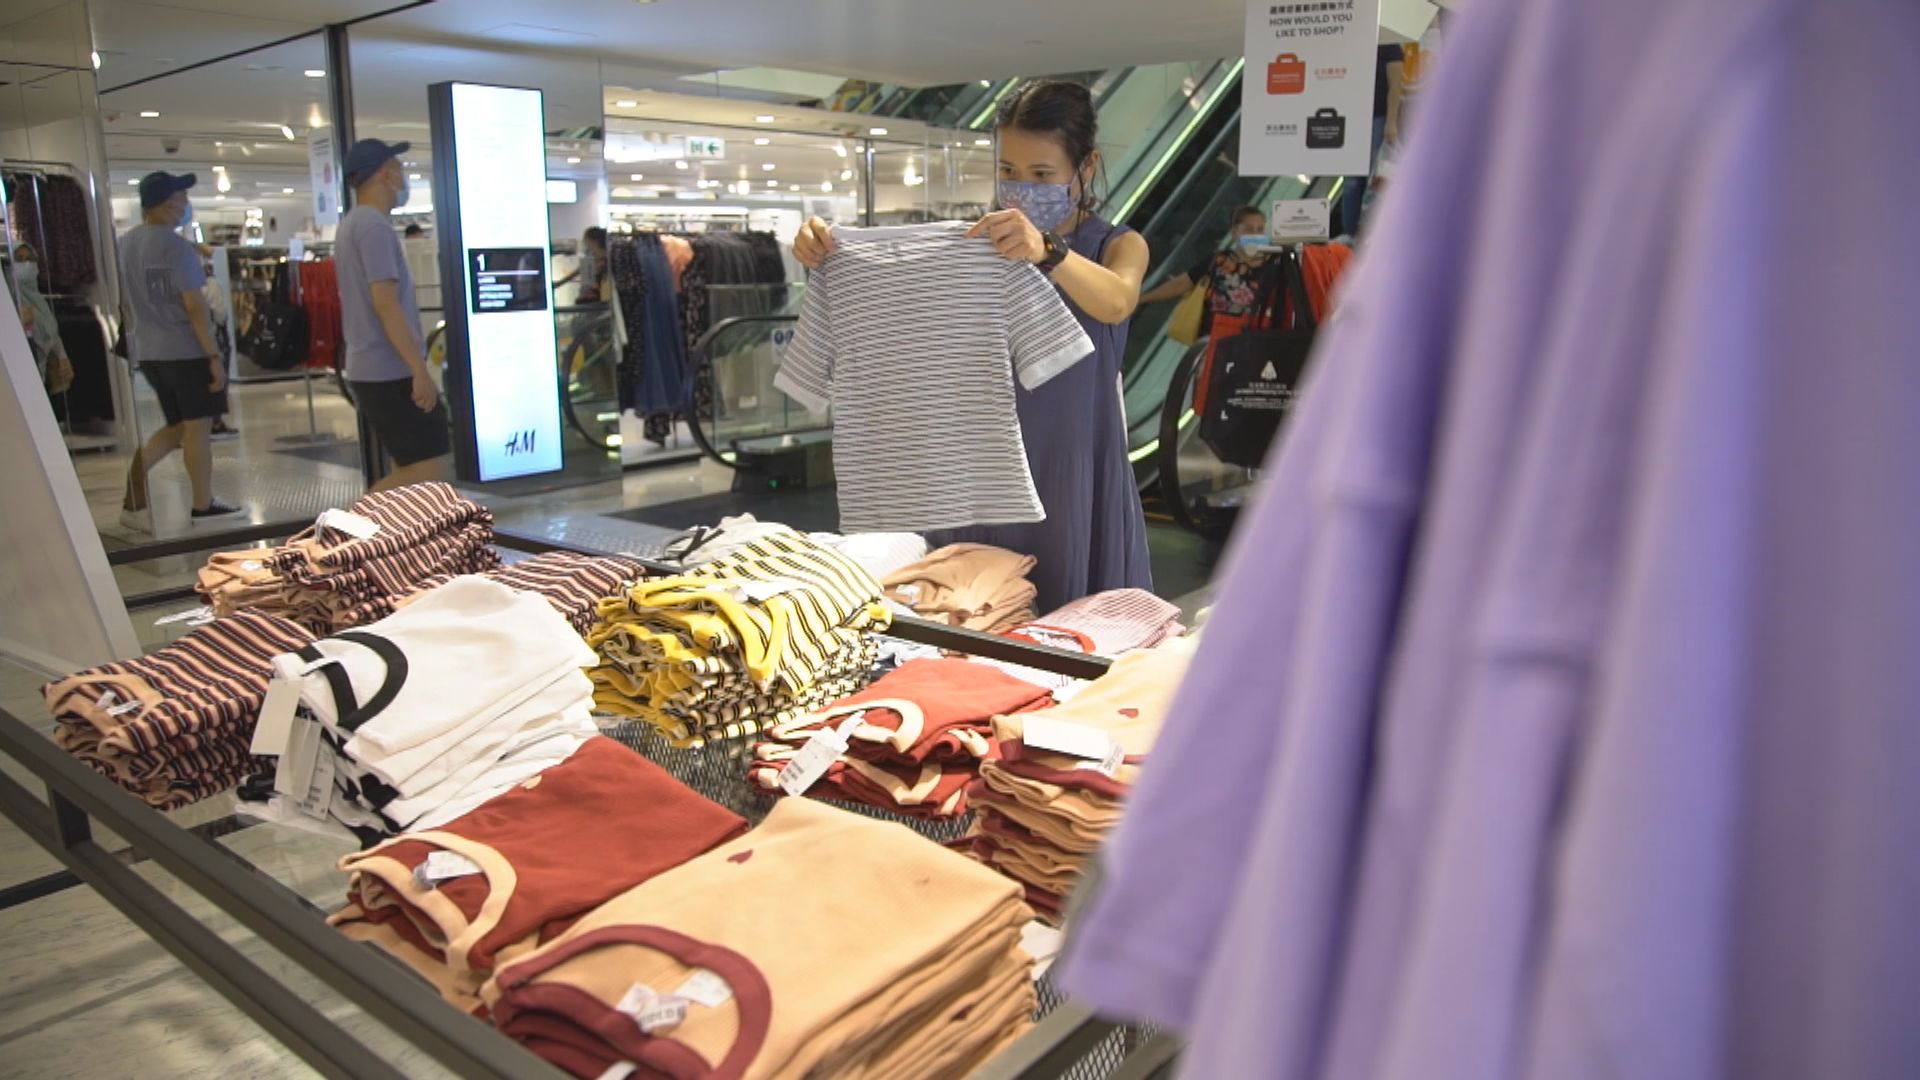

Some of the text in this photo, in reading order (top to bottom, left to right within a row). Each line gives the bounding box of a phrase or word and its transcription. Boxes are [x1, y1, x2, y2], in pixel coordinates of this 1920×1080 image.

[1269, 13, 1353, 26] HOW WOULD YOU
[1275, 26, 1345, 38] LIKE TO SHOP?
[476, 253, 486, 271] 1
